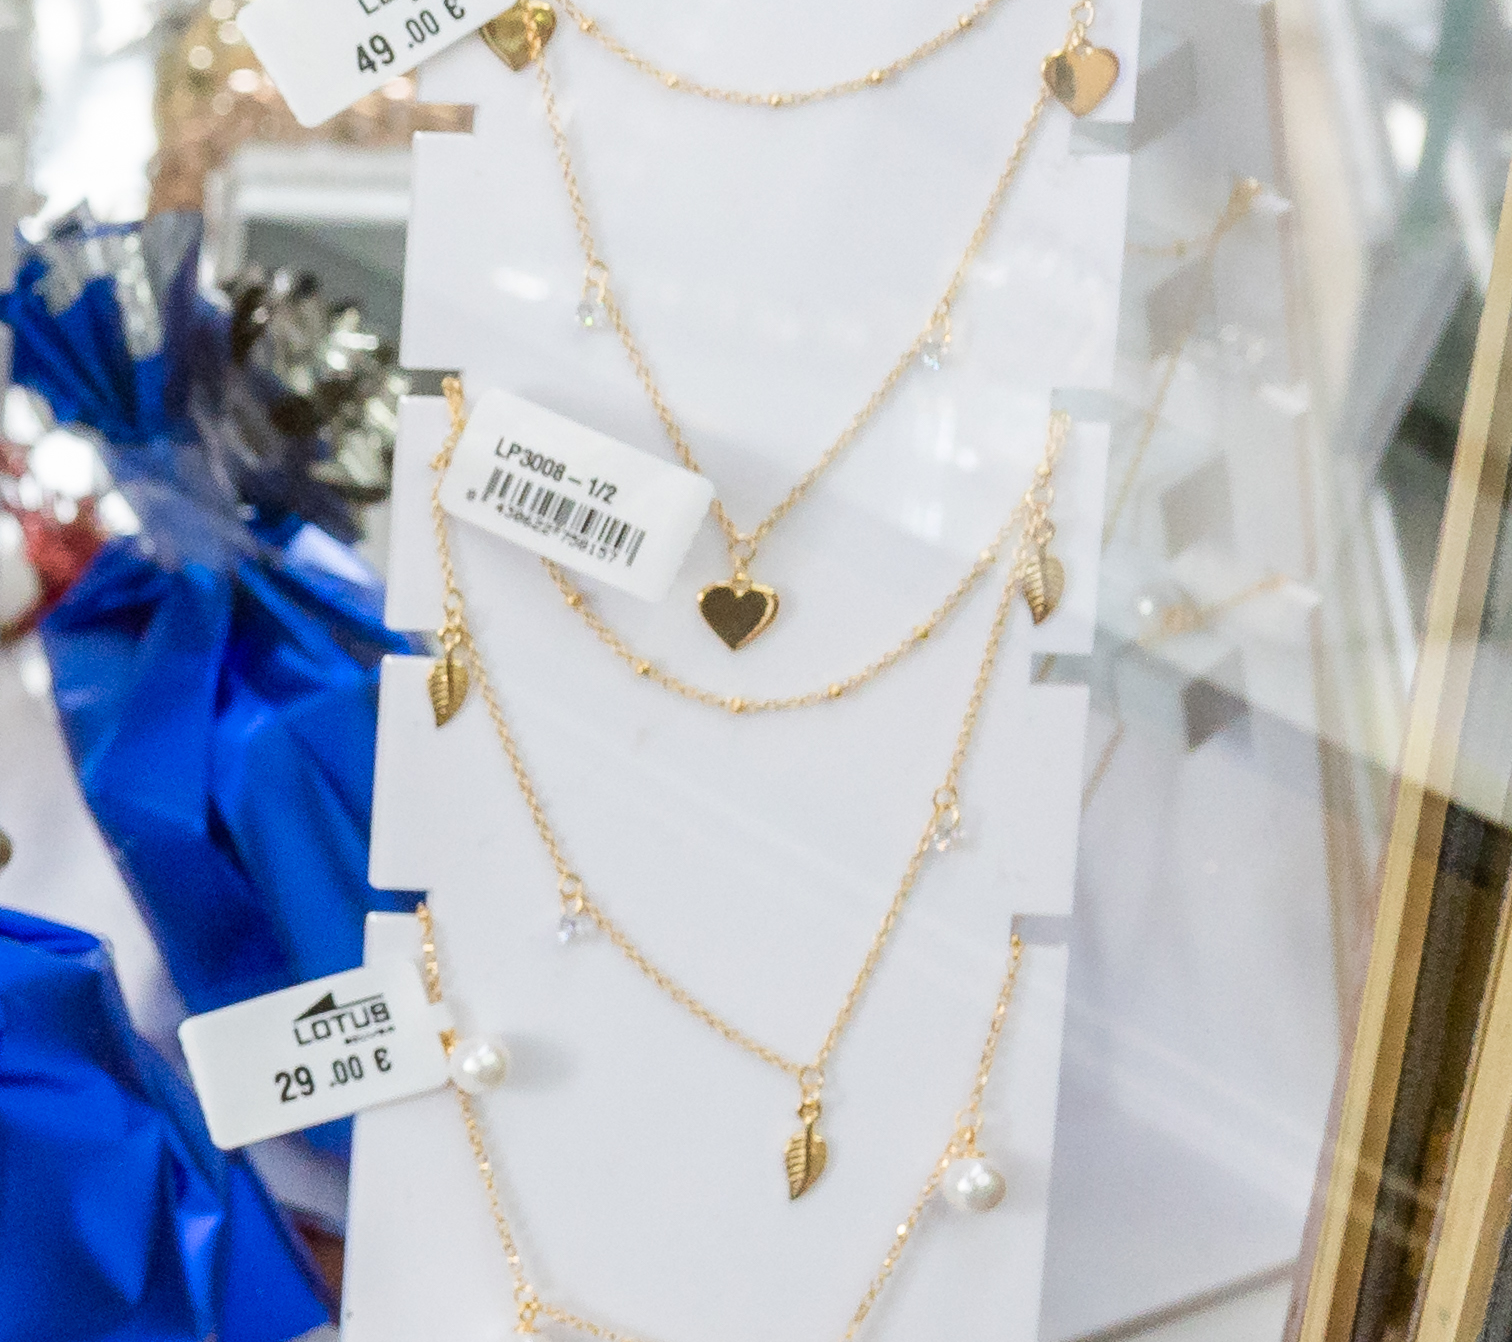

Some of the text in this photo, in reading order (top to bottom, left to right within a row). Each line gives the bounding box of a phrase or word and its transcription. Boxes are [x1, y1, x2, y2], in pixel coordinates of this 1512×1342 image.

[357, 34, 395, 74] 49
[406, 9, 440, 49] .00
[294, 1001, 391, 1047] LOTUS
[275, 1047, 393, 1104] 29 .00 €
